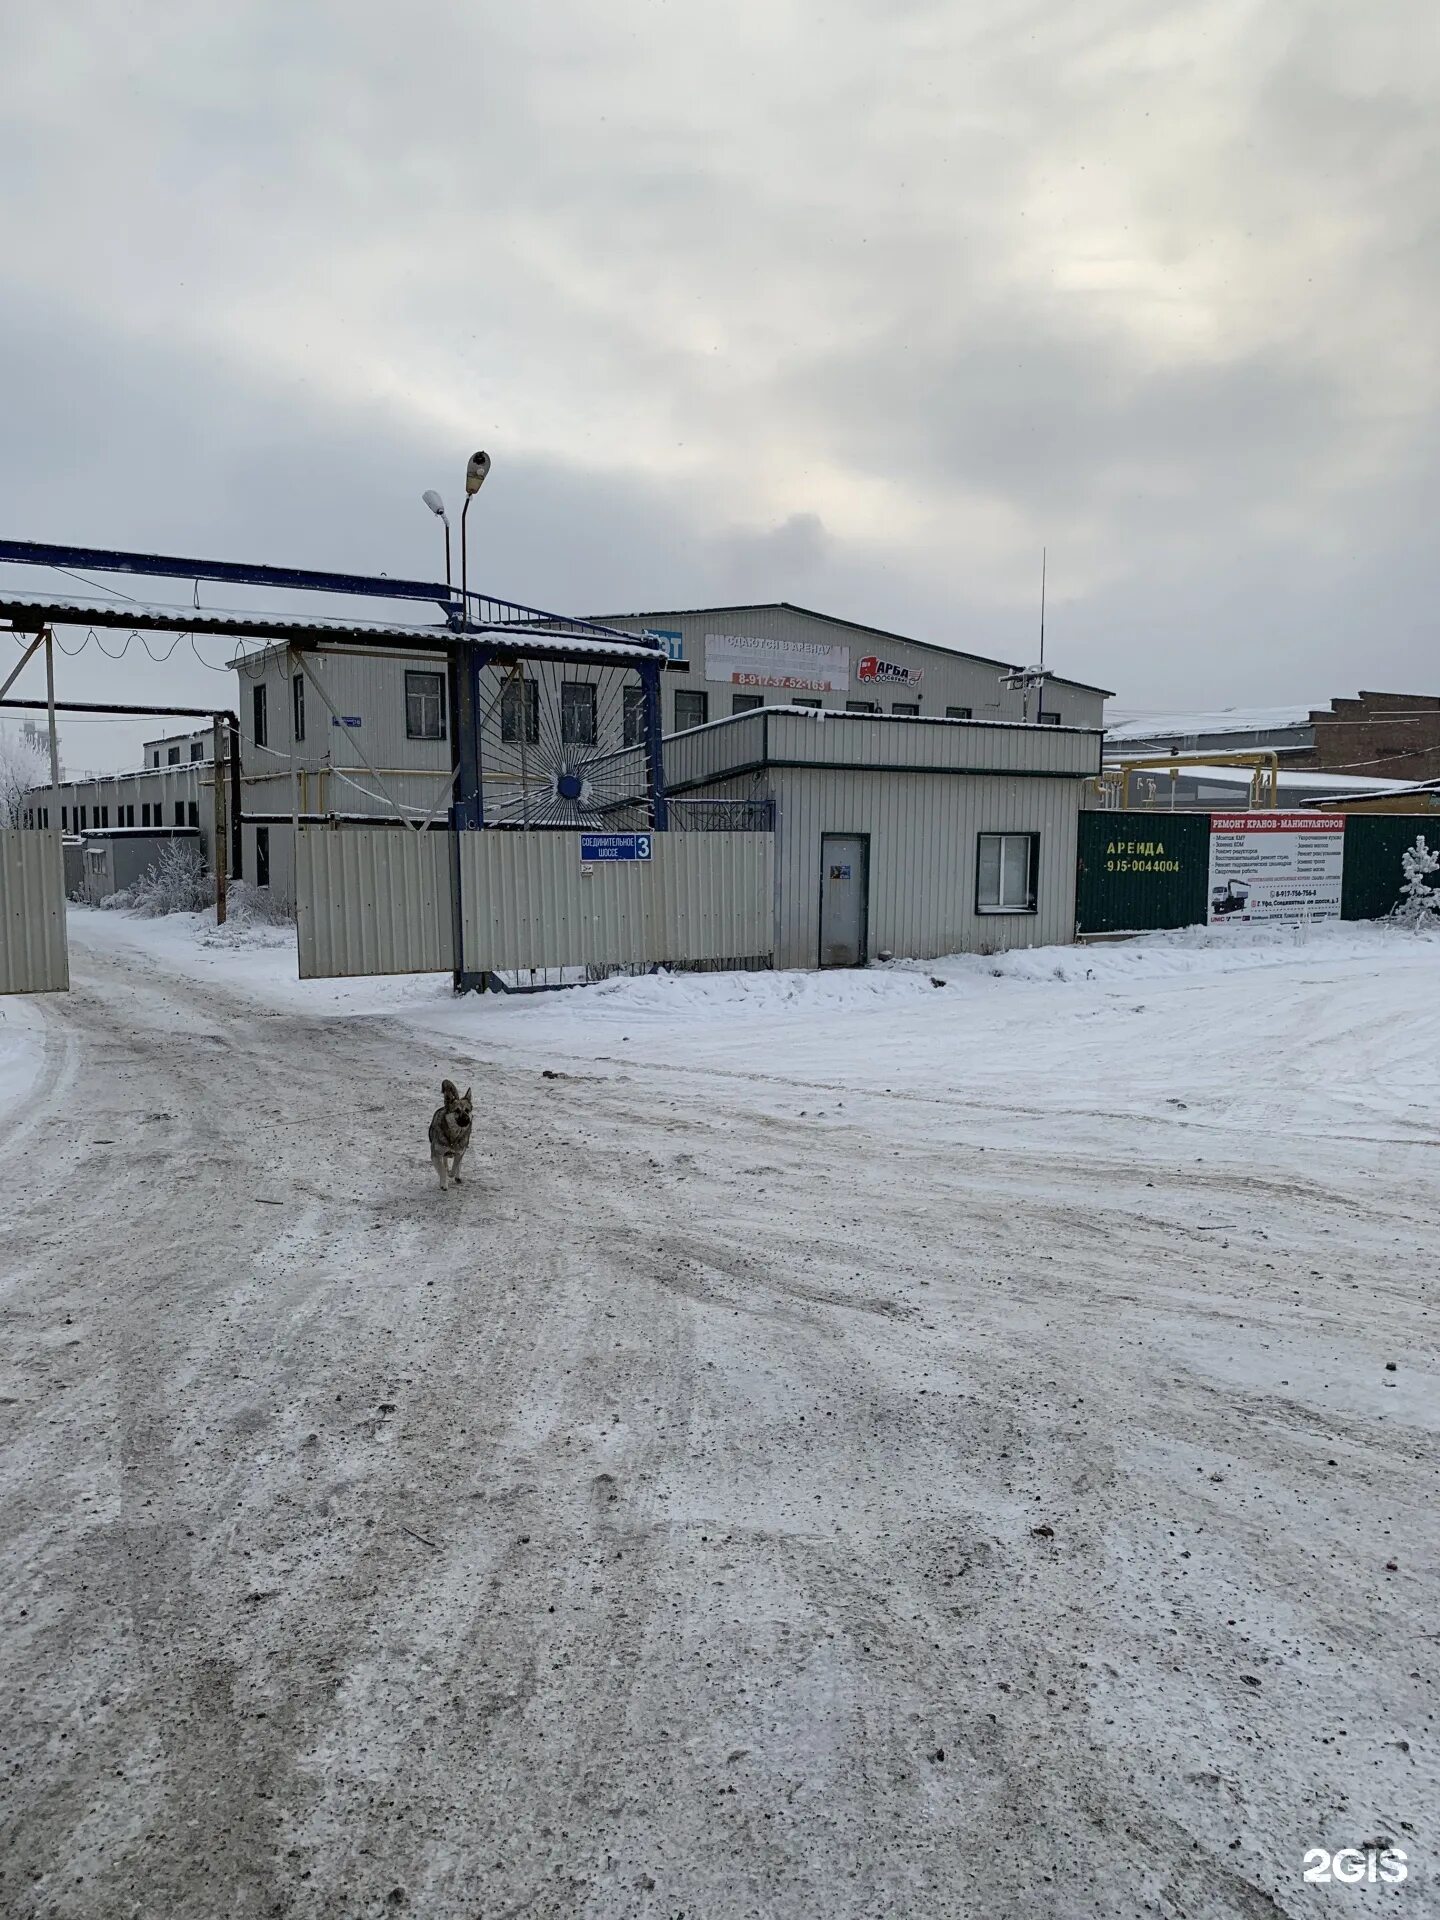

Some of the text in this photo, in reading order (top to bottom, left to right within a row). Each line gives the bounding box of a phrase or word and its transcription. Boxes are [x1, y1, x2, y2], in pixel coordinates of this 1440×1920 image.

[790, 642, 832, 656] АРЕНДУ
[876, 661, 909, 678] АРБА
[738, 674, 826, 691] 8-917-37-52-163
[1212, 819, 1246, 829] РЕМОНТ
[581, 837, 634, 848] СОЕДИНИТЕЛЬНОЕ
[637, 837, 650, 858] 3
[1106, 842, 1164, 856] АРЕНДА
[598, 848, 619, 857] ШОССЕ
